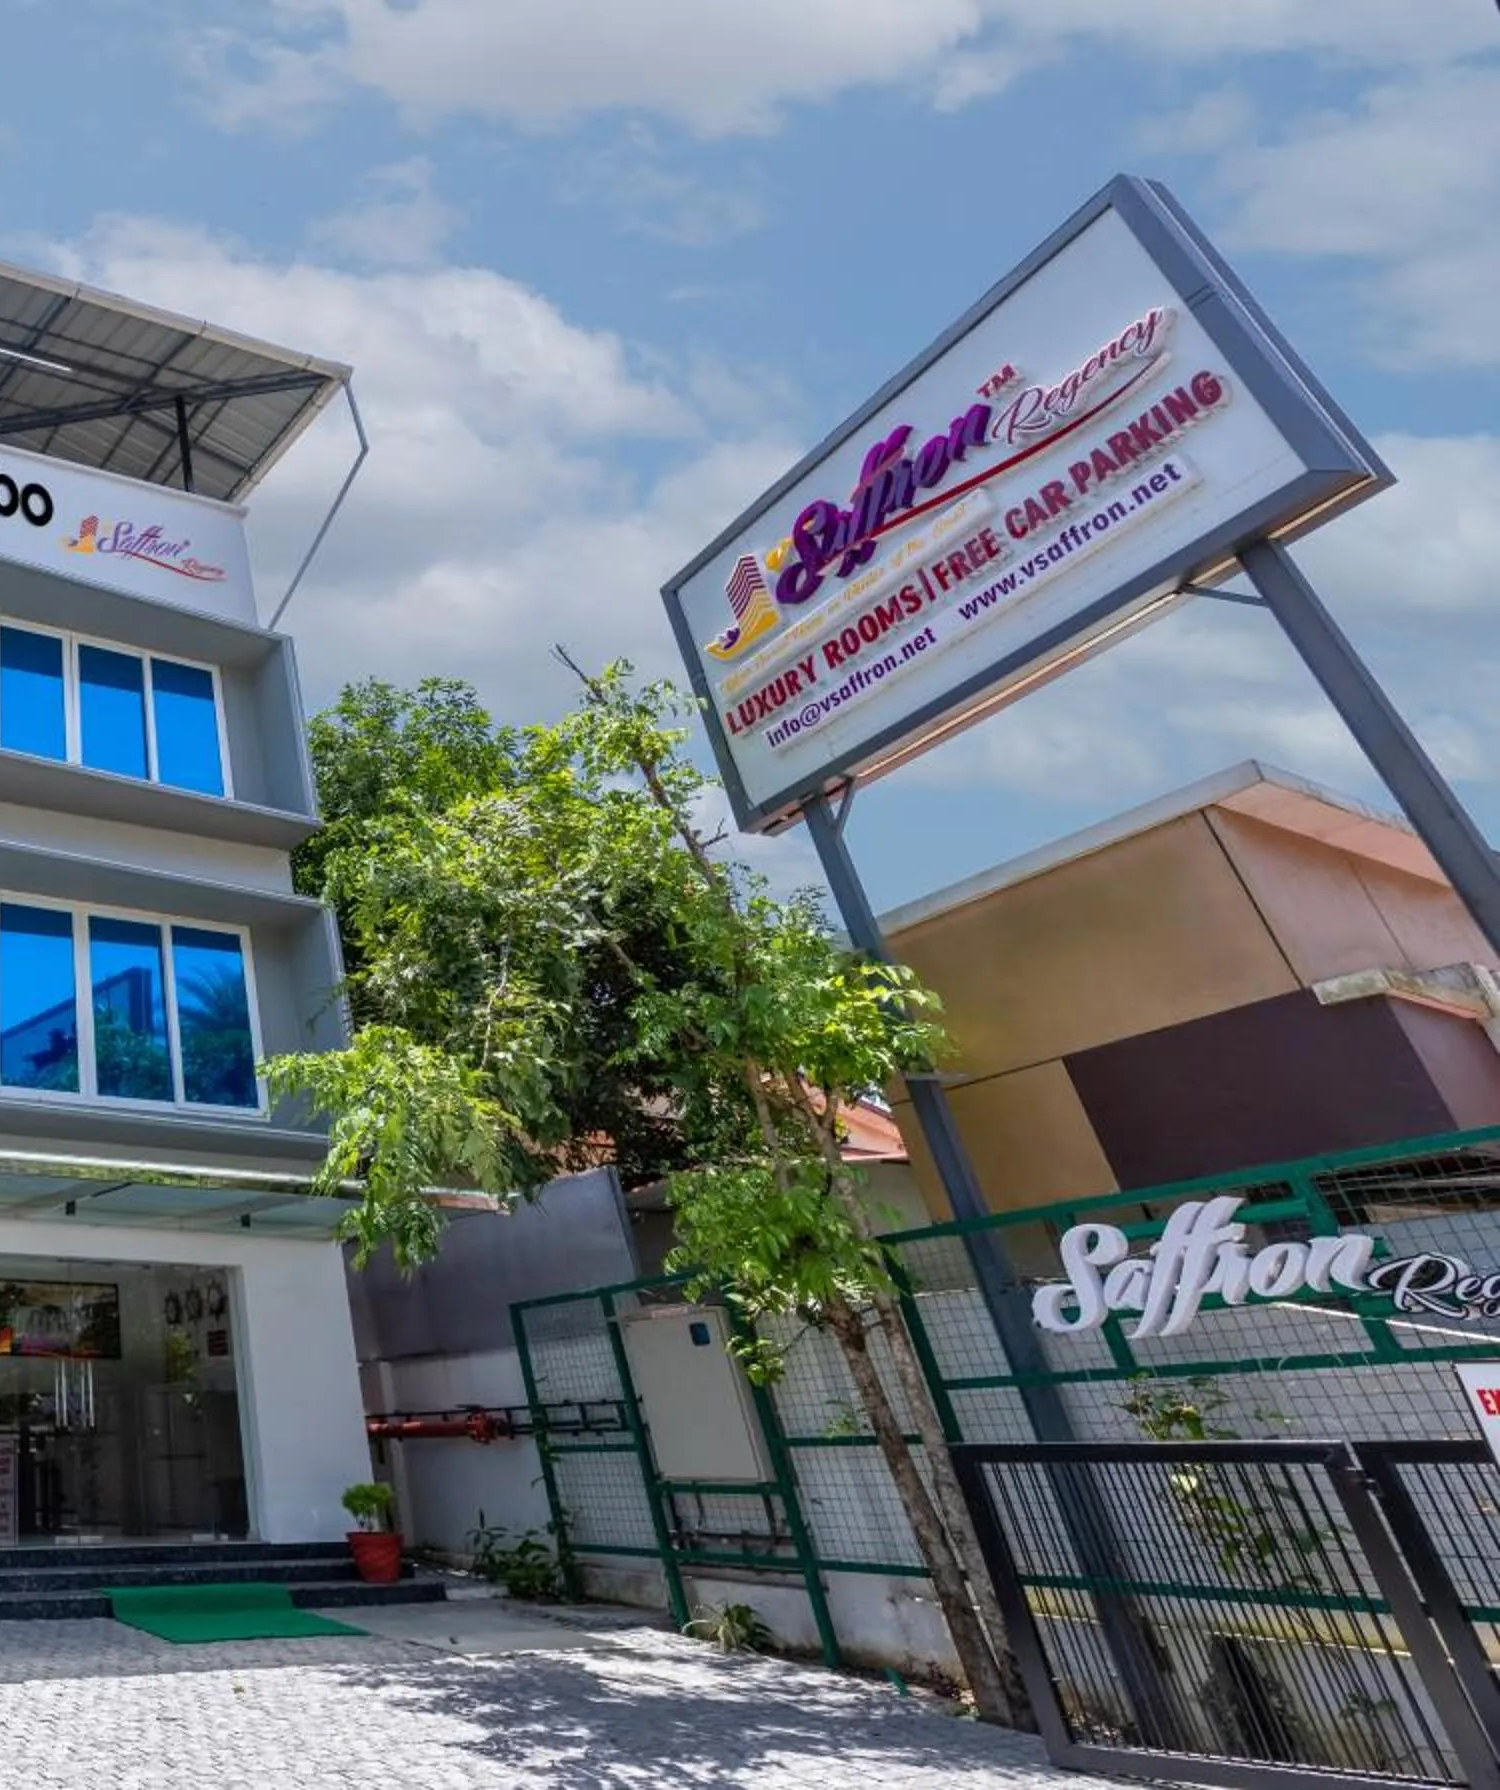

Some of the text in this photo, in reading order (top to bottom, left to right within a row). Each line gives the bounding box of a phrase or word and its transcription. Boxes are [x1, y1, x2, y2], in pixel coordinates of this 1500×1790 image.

[977, 365, 1015, 398] TM
[992, 309, 1163, 444] Regency
[726, 655, 817, 735] LUXURY
[822, 585, 922, 669] ROOMS
[932, 527, 1000, 591] FREE
[1005, 480, 1073, 539] CAR
[1068, 371, 1222, 494] PARKING
[776, 403, 992, 604] Saffron
[766, 626, 937, 748] info@vsaffron.net
[958, 463, 1181, 619] www.vsaffron.net
[1032, 1196, 1375, 1339] Saffron
